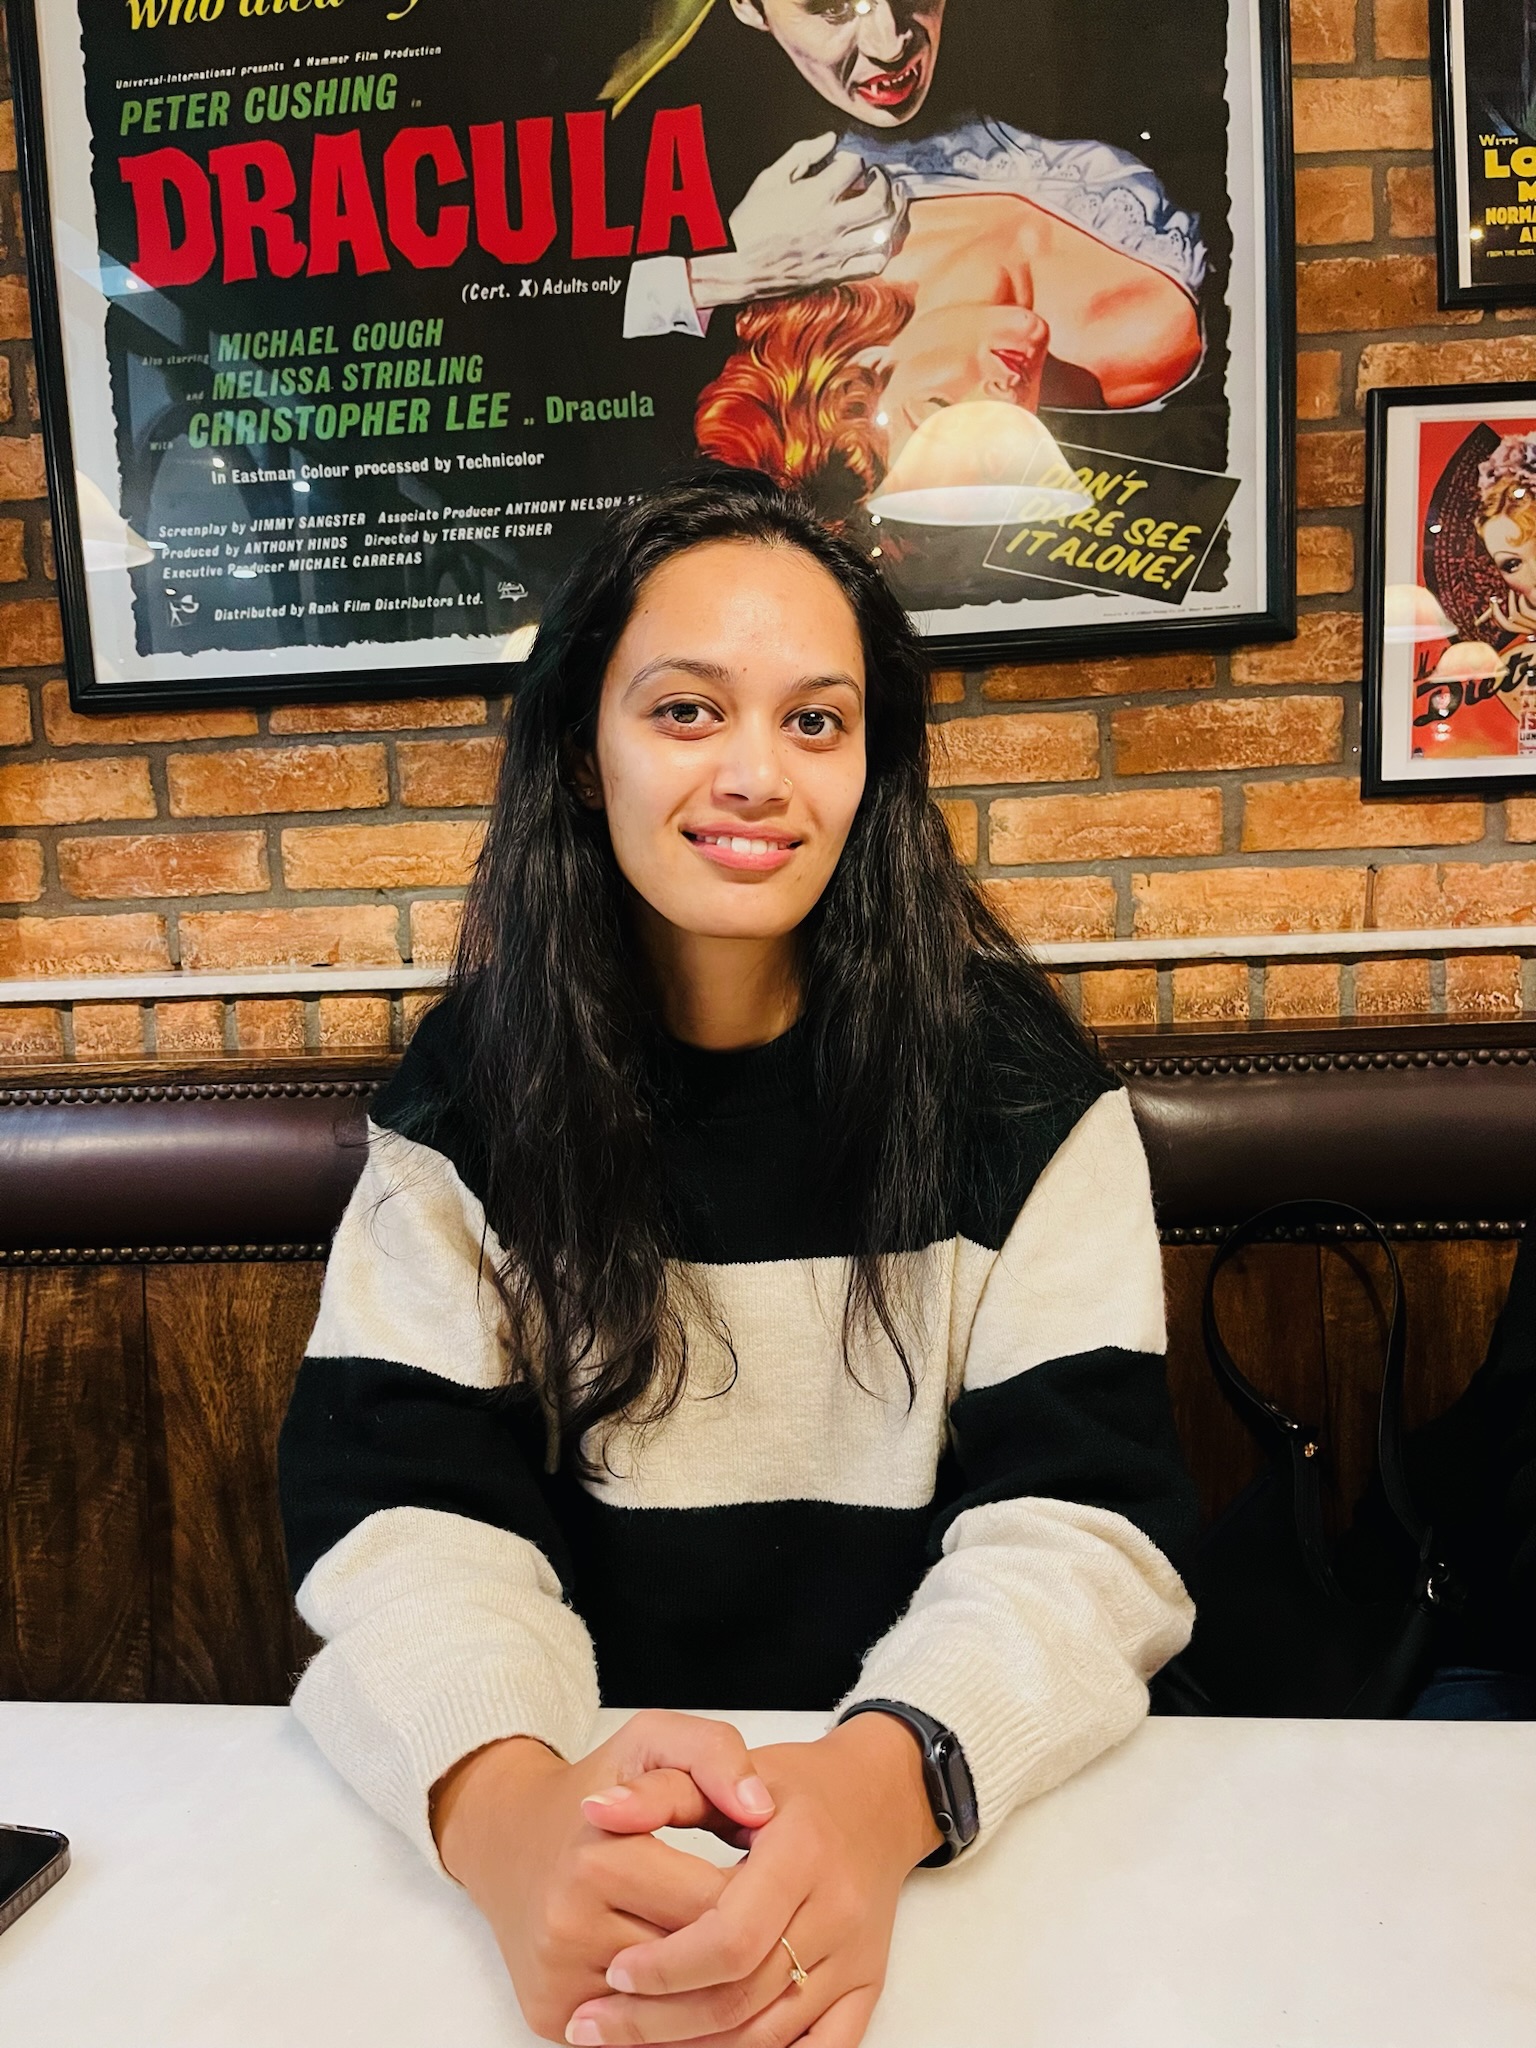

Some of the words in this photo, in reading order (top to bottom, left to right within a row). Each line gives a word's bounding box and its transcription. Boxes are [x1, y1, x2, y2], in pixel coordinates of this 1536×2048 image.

[115, 67, 236, 90] Universal-International
[240, 62, 285, 77] presents
[293, 58, 300, 68] A
[306, 55, 350, 67] Hammer
[355, 51, 379, 63] Film
[383, 46, 442, 60] Production
[120, 90, 230, 136] PETER
[244, 73, 398, 124] CUSHING
[118, 105, 727, 288] DRACULA
[461, 283, 511, 304] (Cert.
[518, 279, 539, 298] X)
[542, 277, 589, 295] Adults
[592, 275, 622, 295] only
[217, 325, 339, 363] MICHAEL
[352, 317, 444, 353] GOUGH
[212, 365, 331, 401] MELISSA
[341, 354, 484, 392] STRIBLING
[188, 397, 430, 449] CHRISTOPHER
[445, 391, 511, 432] LEE
[546, 390, 655, 424] Dracula
[231, 465, 296, 484] Eastman
[301, 465, 350, 480] Colour
[354, 456, 430, 479] processed
[434, 456, 451, 473] by
[456, 450, 545, 471] Technicolor
[1036, 461, 1149, 507] DON'T
[158, 522, 228, 538] Screenplay
[231, 520, 247, 536] by
[249, 517, 296, 533] JIMMY
[299, 512, 367, 530] SANGSTER
[378, 510, 440, 525] Associate
[443, 506, 502, 521] Producer
[505, 499, 567, 516] ANTHONY
[161, 544, 220, 560] Produced
[224, 543, 241, 558] by
[243, 538, 303, 555] ANTHONY
[306, 535, 348, 551] HINDS
[364, 532, 419, 547] Directed
[422, 531, 439, 545] by
[441, 525, 500, 542] TERENCE
[504, 522, 553, 538] FISHER
[1018, 494, 1125, 537] DARE
[1122, 517, 1203, 552] SEE
[162, 566, 223, 580] Executive
[288, 555, 348, 572] MICHAEL
[352, 551, 423, 568] CARRERAS
[1005, 527, 1058, 557] IT
[1047, 535, 1197, 591] ALONE!
[213, 604, 287, 622] Distributed
[290, 604, 305, 618] by
[308, 602, 340, 616] Rank
[343, 599, 371, 613] Film
[374, 593, 454, 612] Distributors
[457, 592, 484, 606] Ltd.
